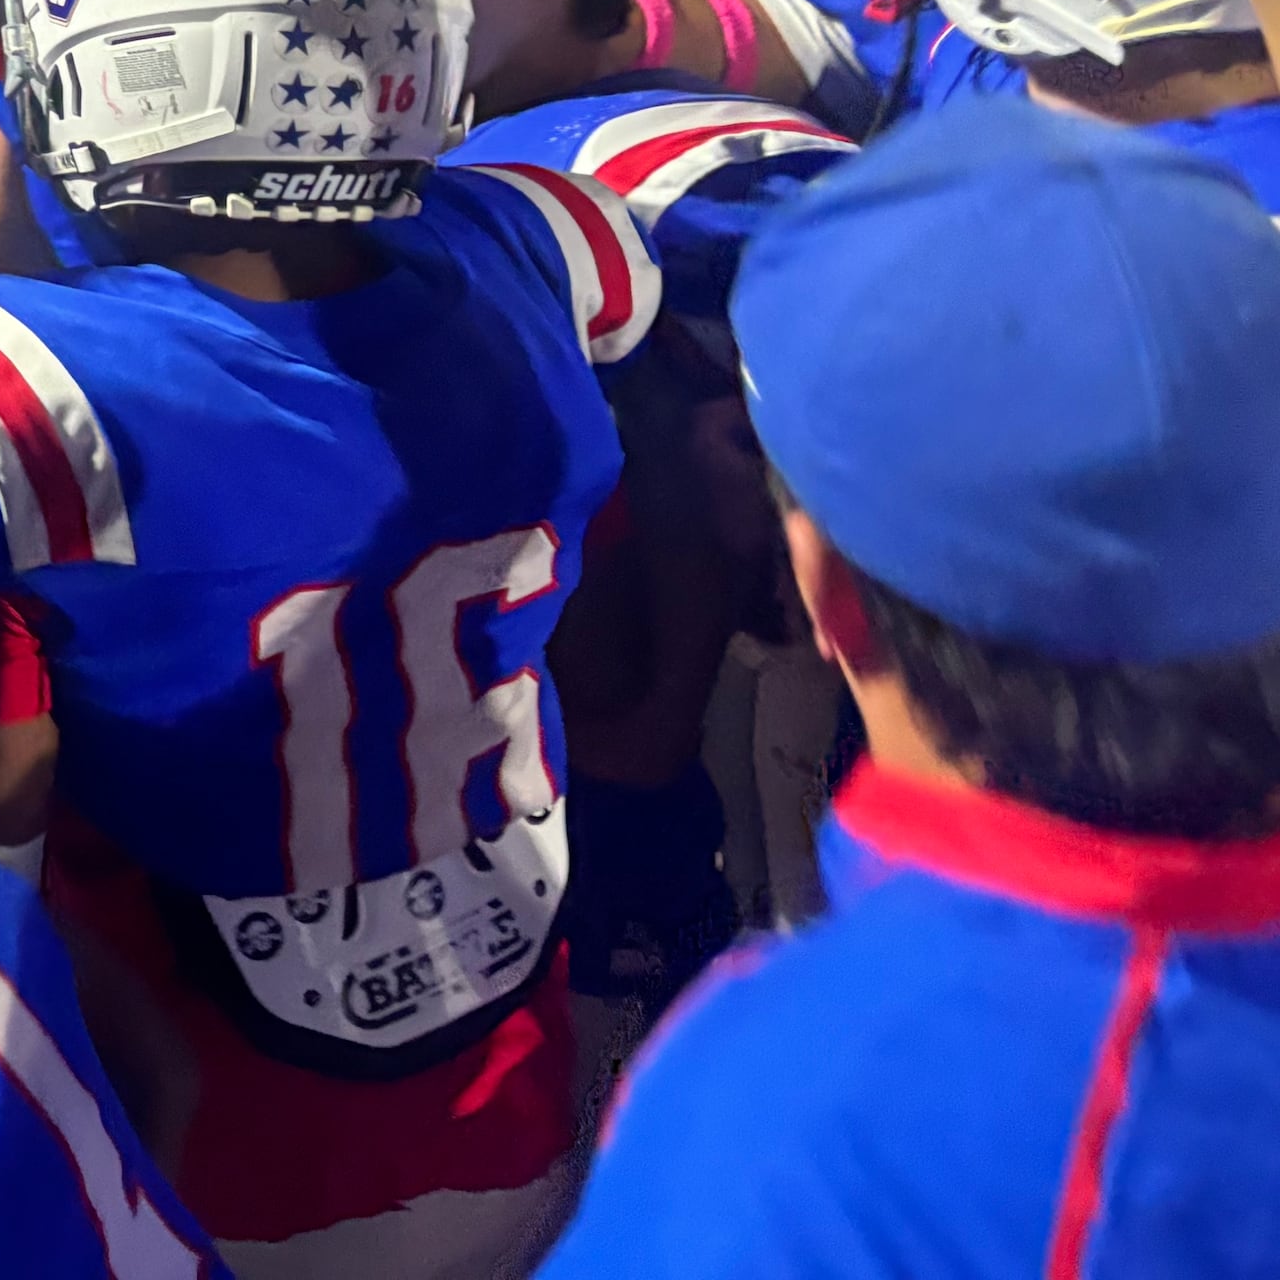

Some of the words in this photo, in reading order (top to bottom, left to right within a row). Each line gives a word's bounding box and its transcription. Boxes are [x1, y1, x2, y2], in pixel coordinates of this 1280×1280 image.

[376, 73, 416, 113] 16
[253, 164, 401, 201] schutt
[249, 519, 563, 896] 16
